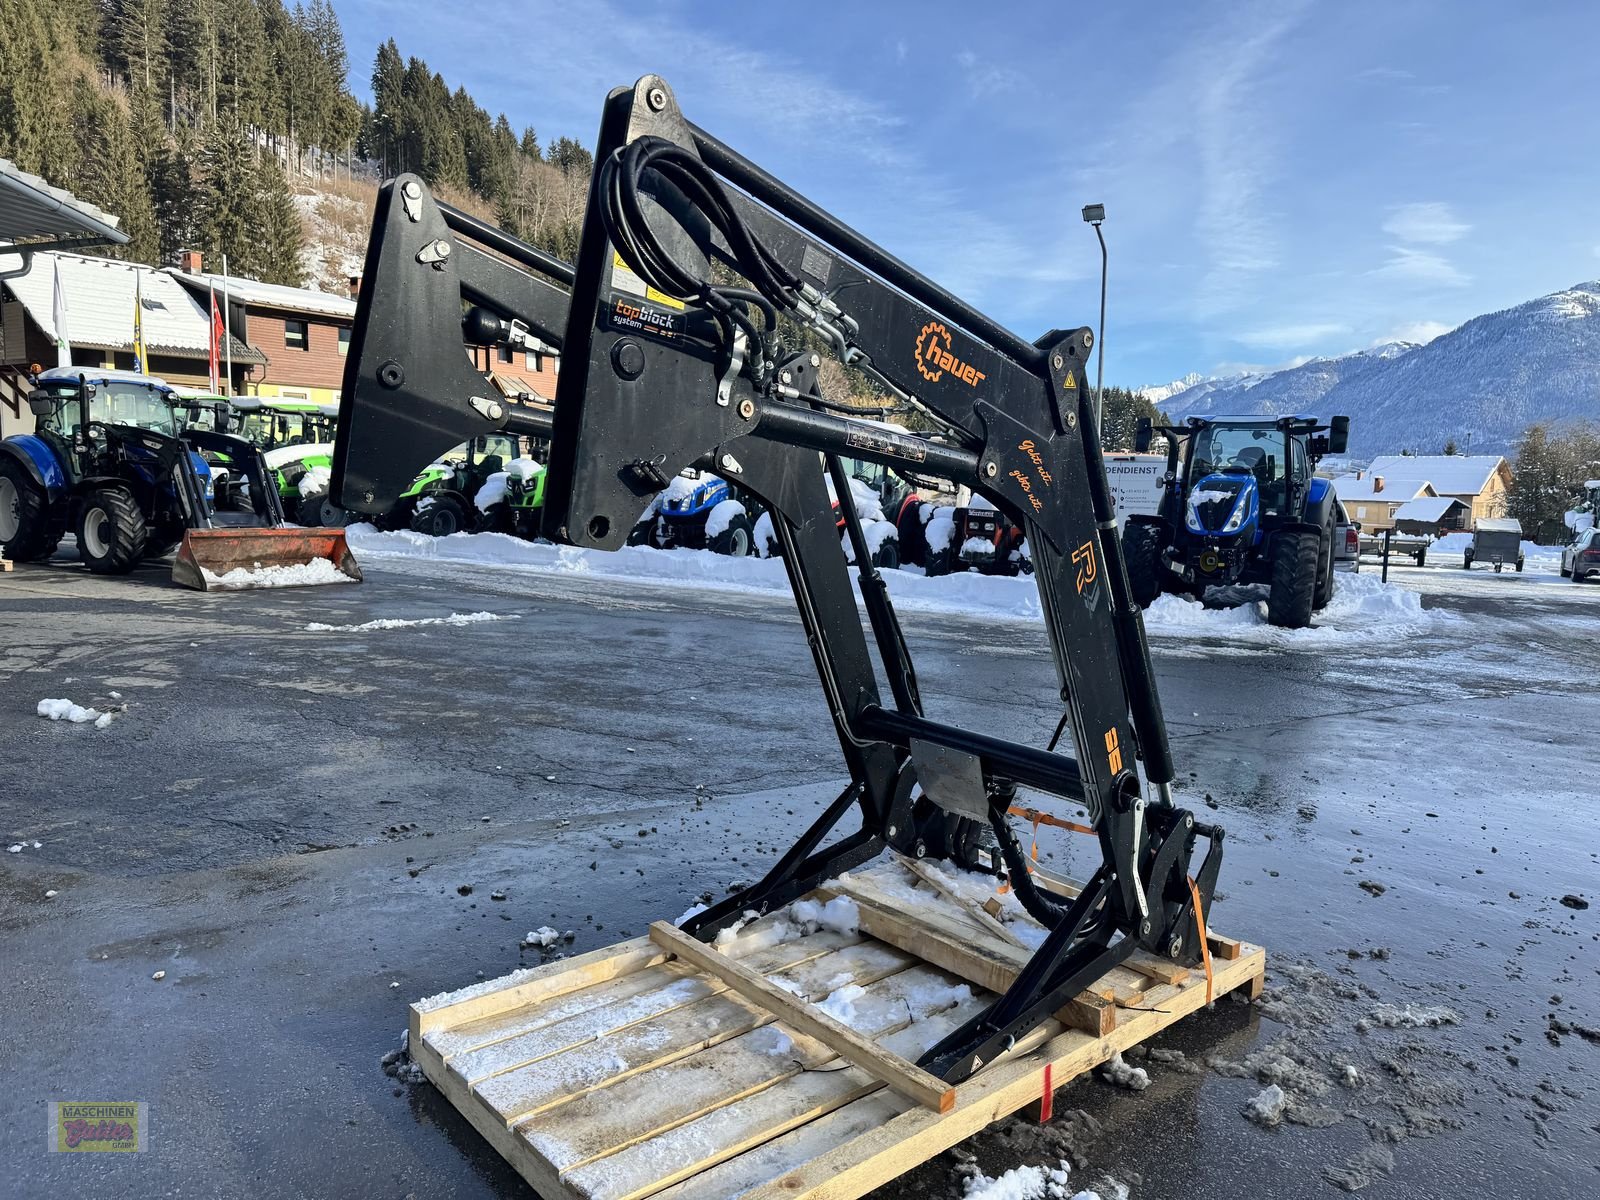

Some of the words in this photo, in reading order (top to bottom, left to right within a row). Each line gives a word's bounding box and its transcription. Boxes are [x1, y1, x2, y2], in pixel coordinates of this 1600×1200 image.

[613, 315, 642, 329] system
[616, 299, 675, 328] topblock
[926, 335, 987, 388] hauer
[1018, 440, 1042, 465] Geht
[1008, 470, 1030, 492] gibts
